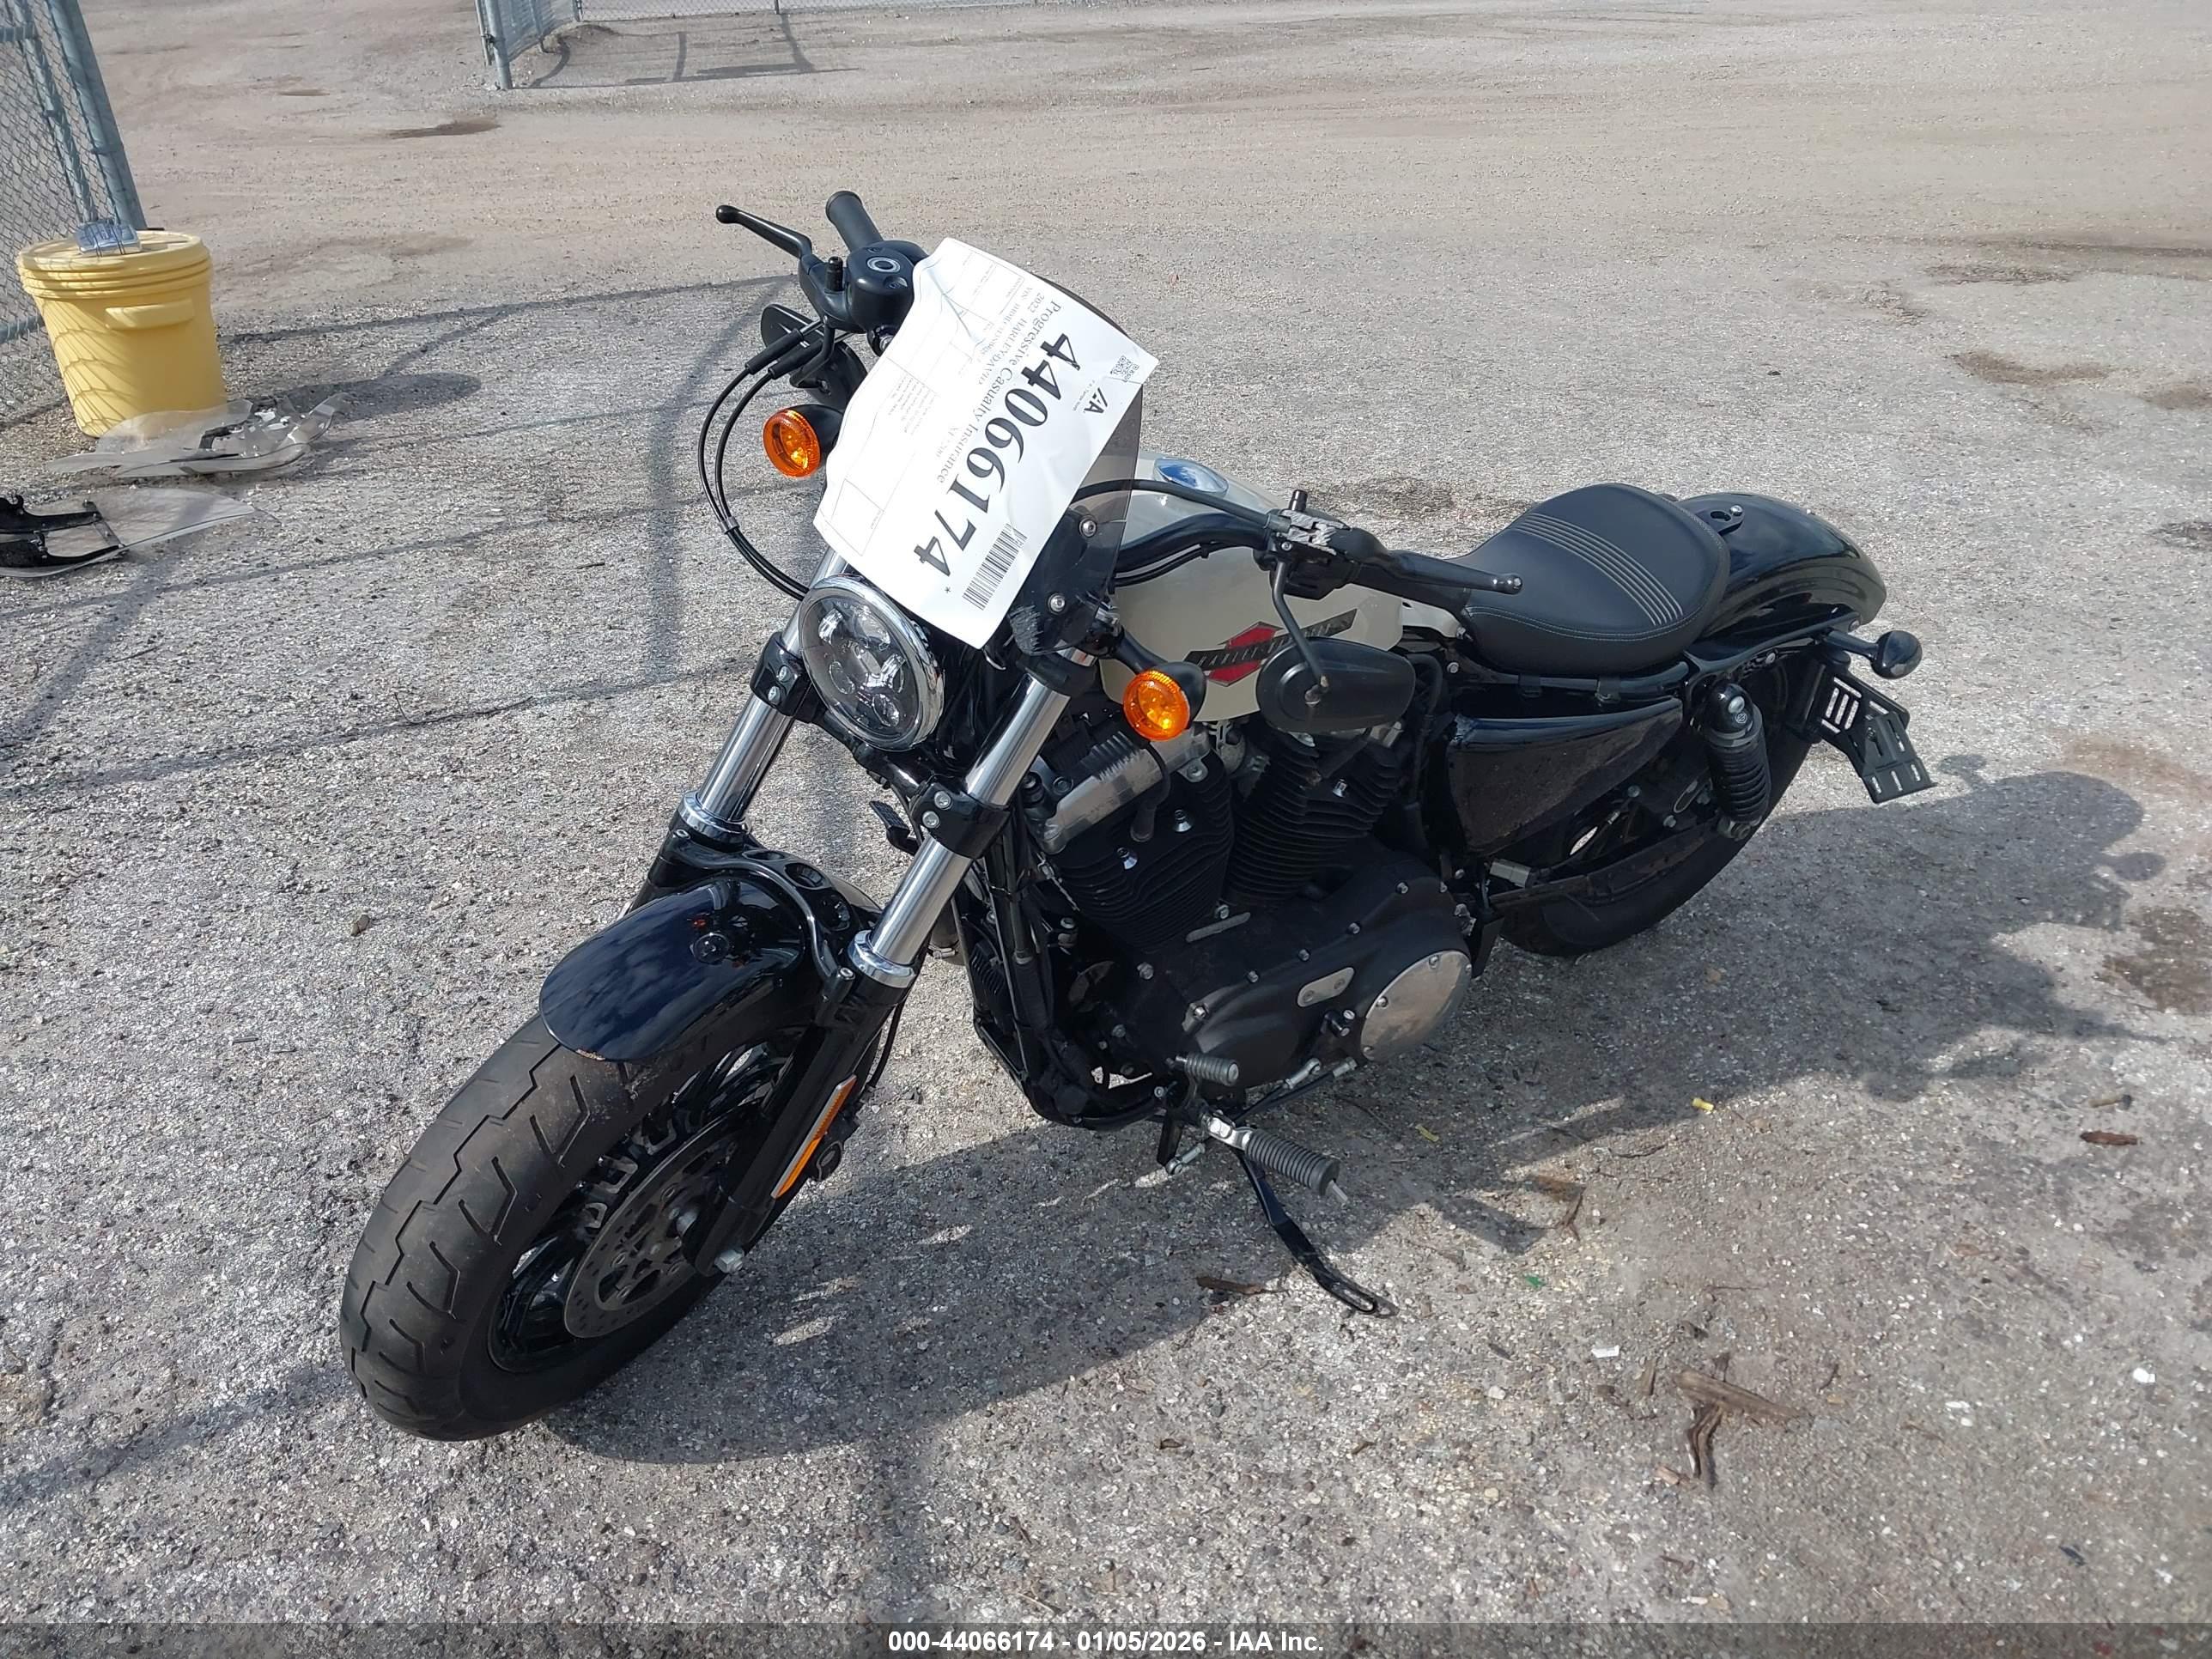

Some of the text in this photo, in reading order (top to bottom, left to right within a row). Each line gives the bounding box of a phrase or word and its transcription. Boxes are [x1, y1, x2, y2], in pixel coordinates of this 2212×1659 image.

[1026, 291, 1046, 314] 2022
[1008, 300, 1061, 373] Progressive
[971, 366, 1014, 422] Casualty
[915, 334, 1080, 575] 44066174
[935, 422, 979, 484] Insurance
